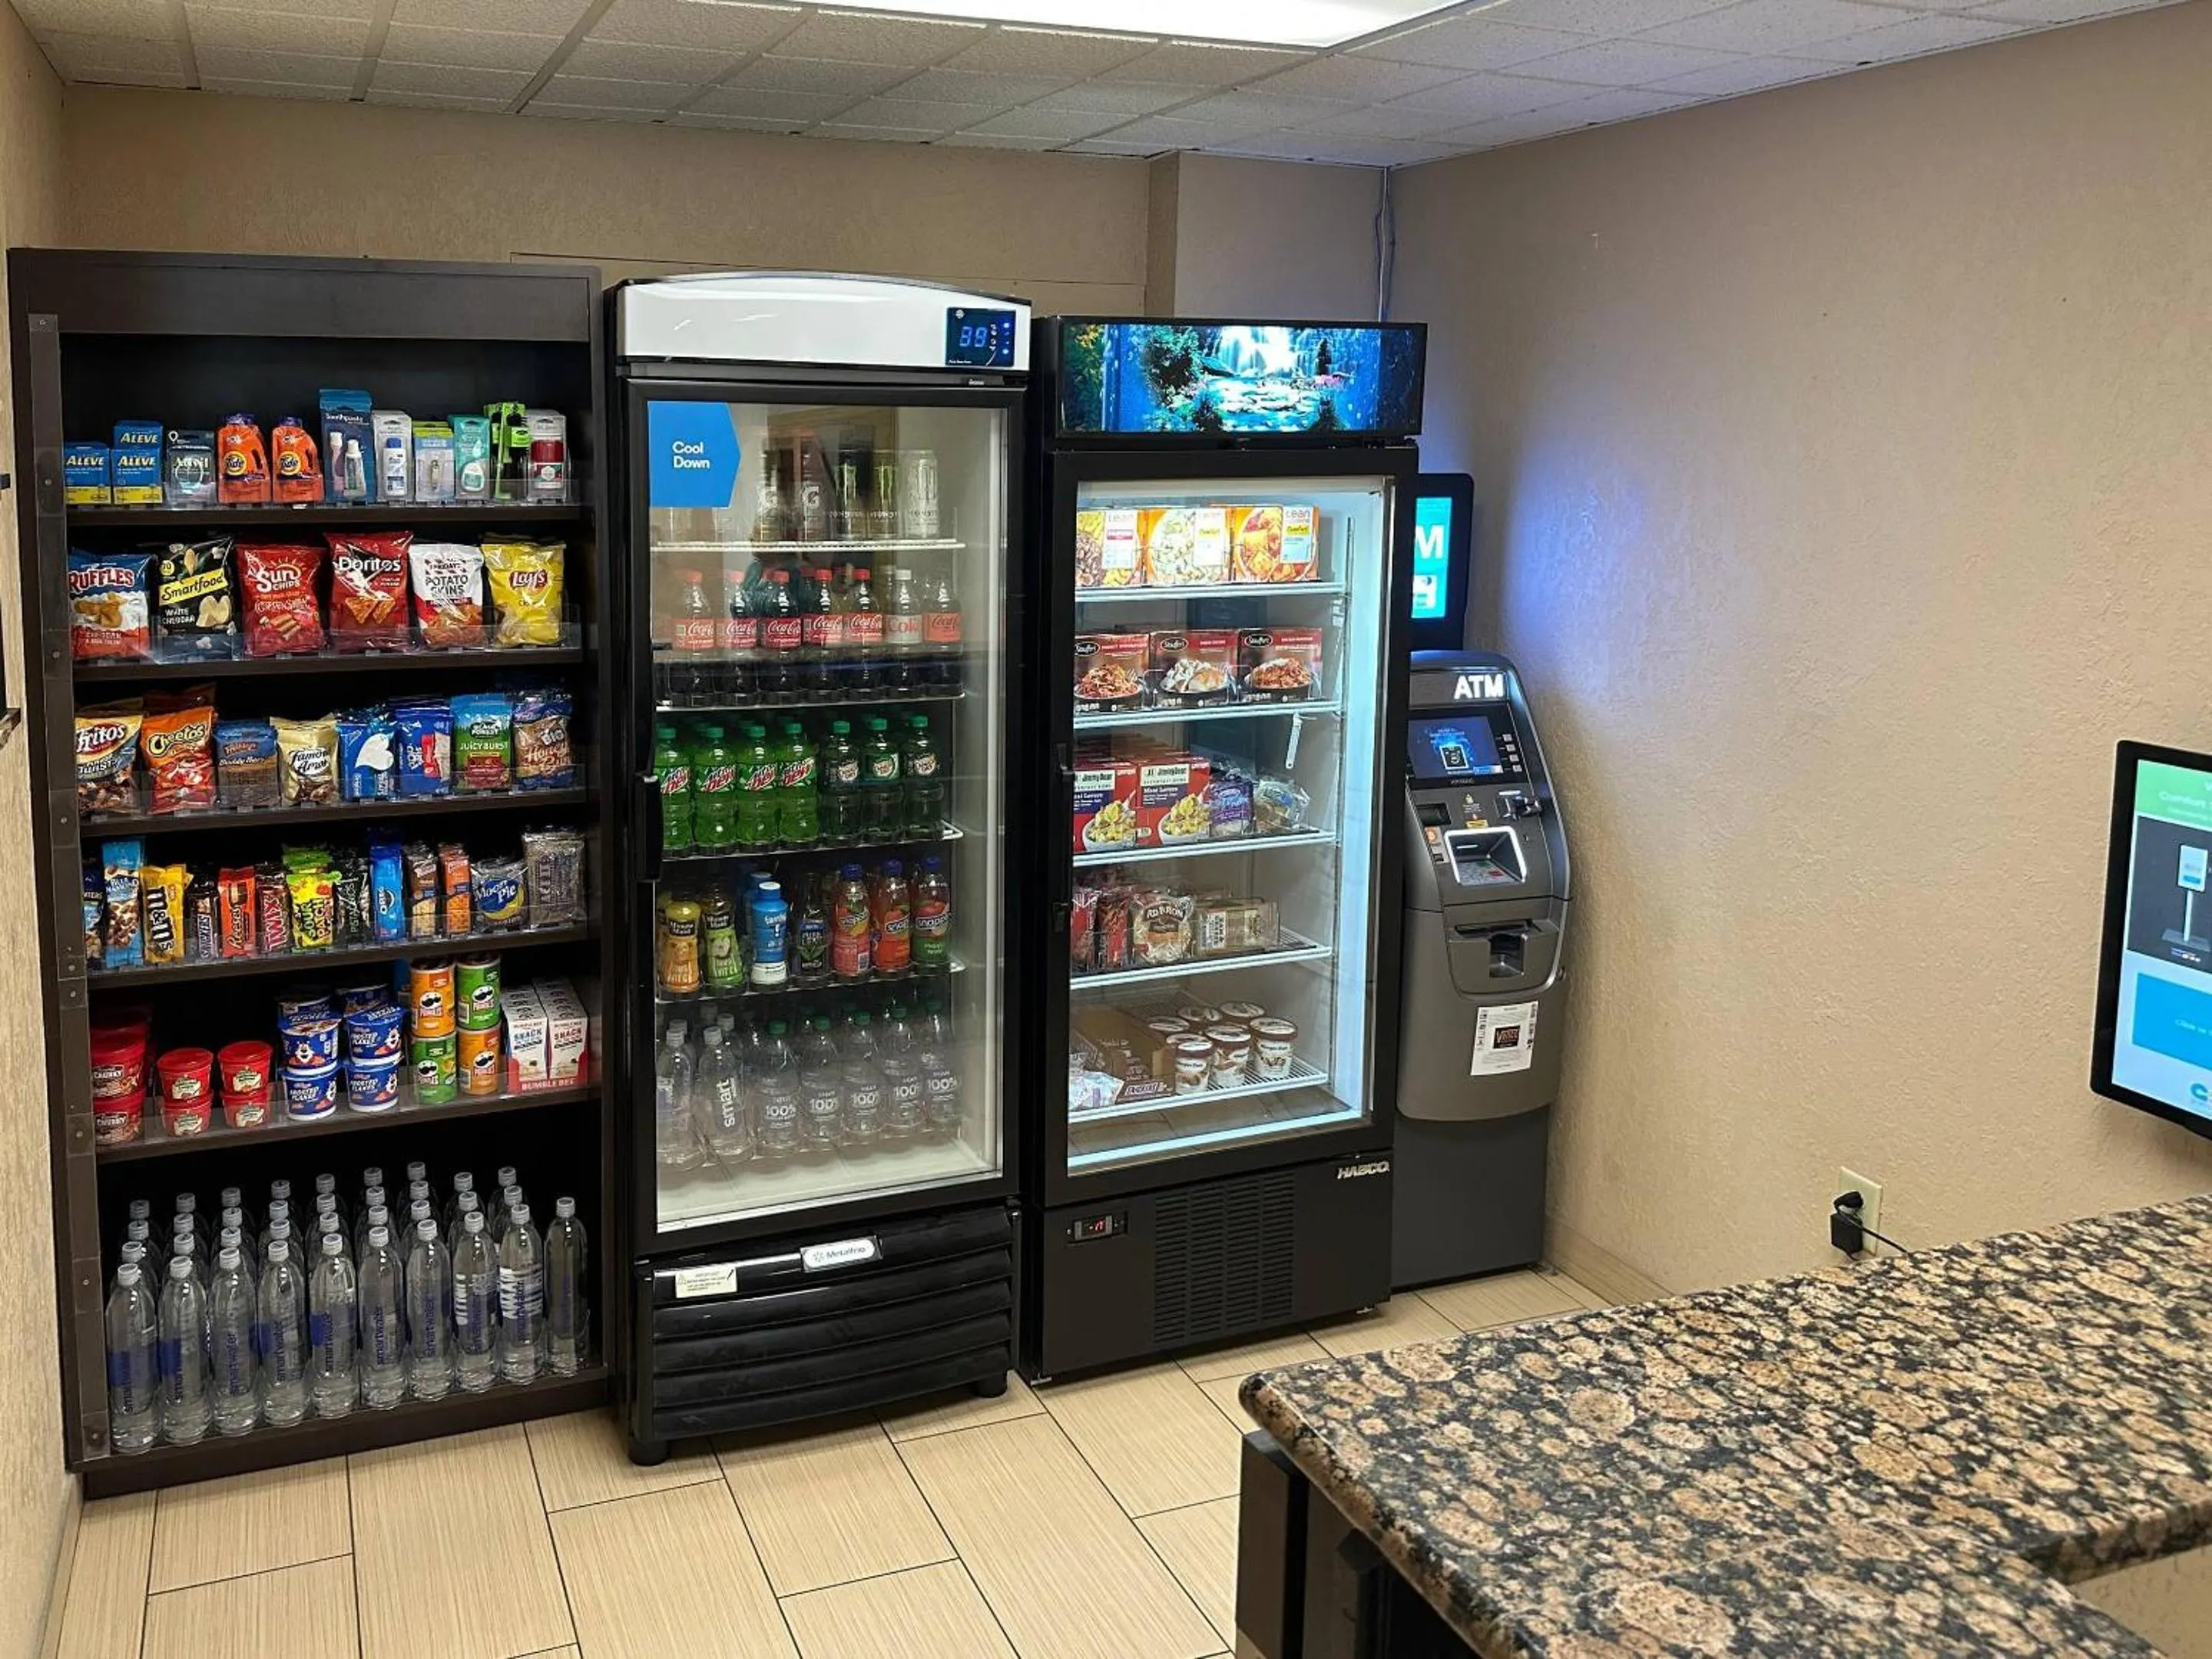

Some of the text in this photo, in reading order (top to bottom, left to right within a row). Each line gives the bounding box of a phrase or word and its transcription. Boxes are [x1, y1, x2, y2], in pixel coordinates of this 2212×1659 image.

[121, 432, 158, 445] ALEVE
[673, 442, 704, 455] Cool
[66, 454, 104, 466] ALEVE
[118, 455, 156, 467] ALEVE
[673, 456, 710, 469] Down
[339, 556, 401, 572] Doritos
[68, 568, 135, 594] RUFFLES
[426, 575, 468, 586] POTATO
[161, 575, 224, 601] Smartfood
[1454, 674, 1504, 700] ATM
[149, 724, 206, 756] Cheetos
[460, 742, 482, 750] JUICY
[302, 902, 316, 938] SOUR
[313, 899, 326, 938] PATCH
[514, 1029, 542, 1041] SNACK
[554, 1028, 581, 1040] SNACK
[1337, 1161, 1390, 1180] HABCO
